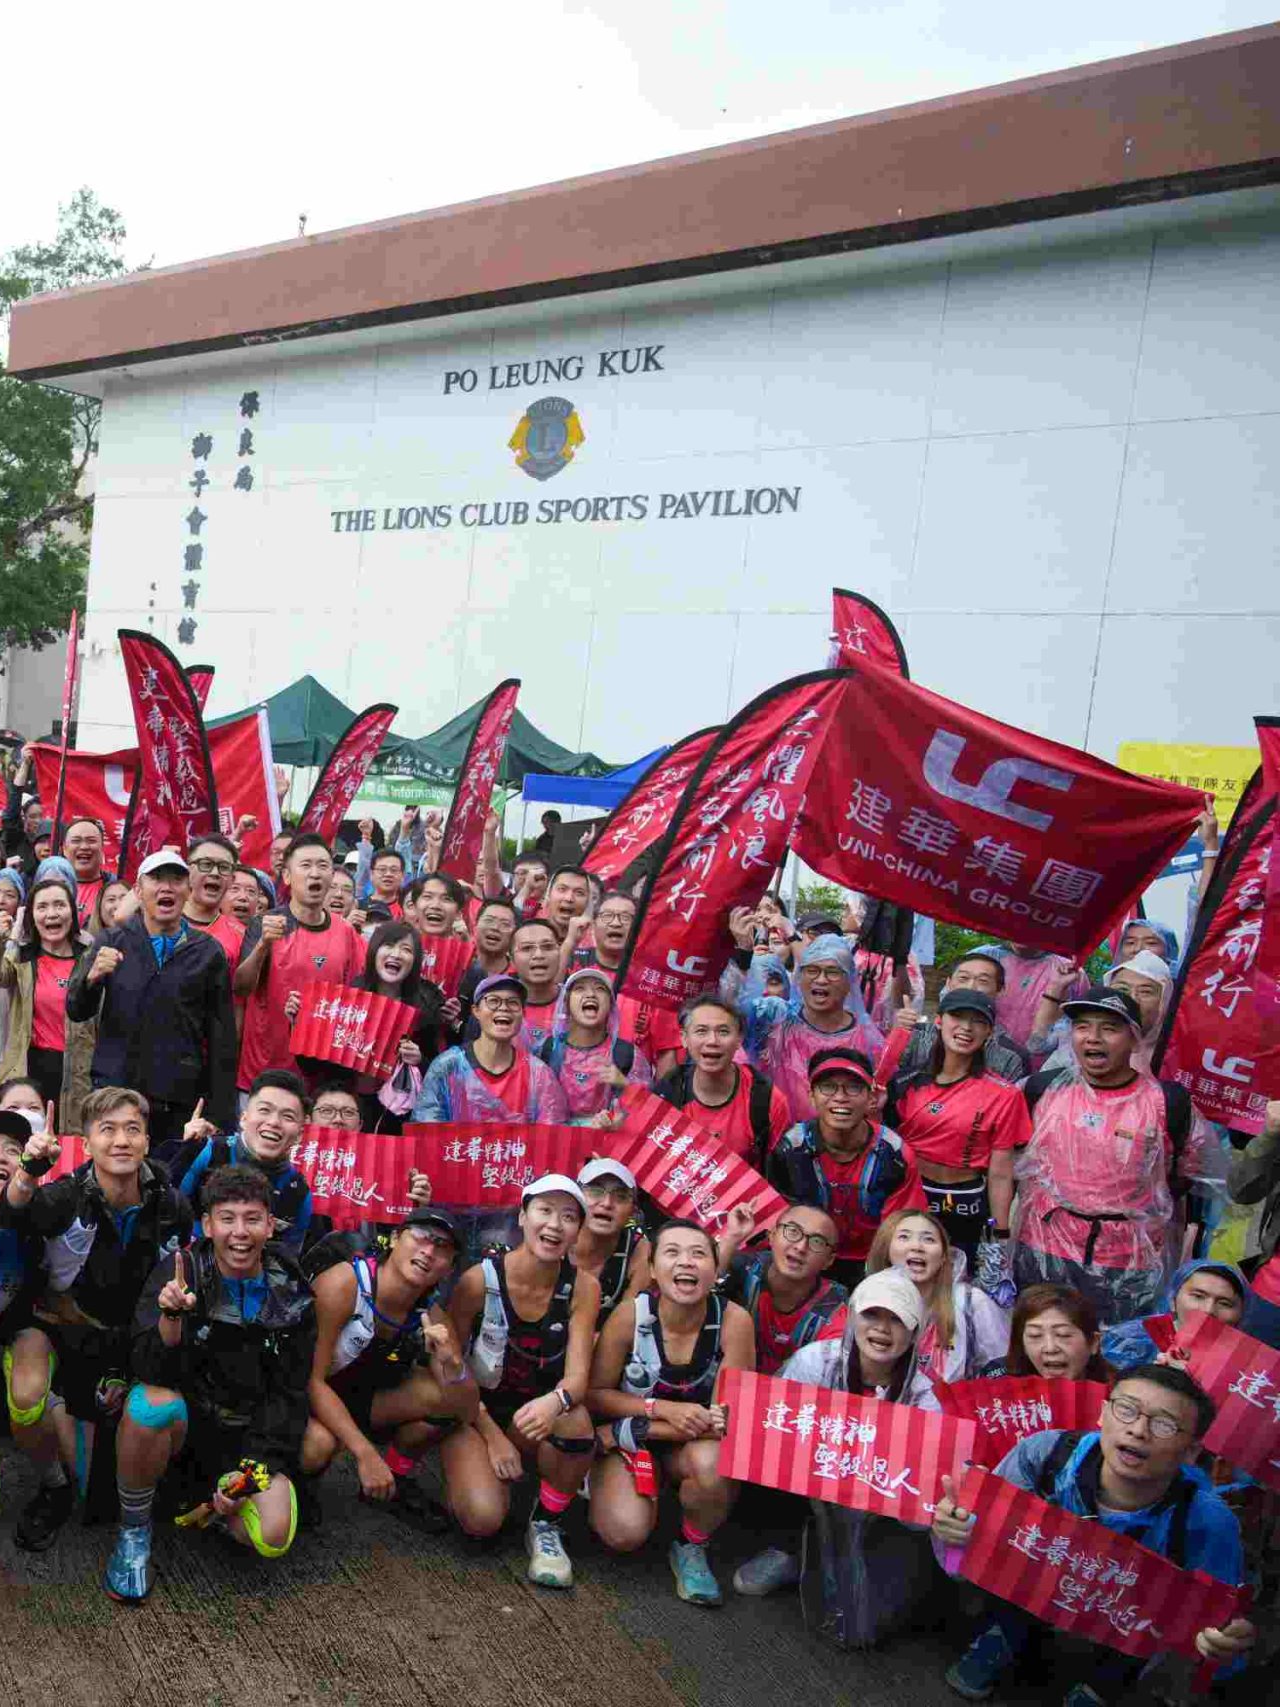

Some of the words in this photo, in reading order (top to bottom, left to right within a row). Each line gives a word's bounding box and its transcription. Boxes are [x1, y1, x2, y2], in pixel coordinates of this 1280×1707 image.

[443, 368, 478, 395] PO
[488, 356, 585, 391] LEUNG
[598, 344, 666, 378] KUK
[233, 390, 260, 492] 保良局
[330, 510, 376, 533] THE
[382, 505, 452, 531] LIONS
[459, 500, 529, 528] CLUB
[536, 494, 649, 525] SPORTS
[658, 486, 802, 520] PAVILION
[844, 777, 1105, 908] 建華集團
[837, 831, 960, 896] UNI-CHINA
[969, 887, 1076, 930] GROUP
[761, 1398, 878, 1458] 建華精神
[812, 1442, 921, 1500] 堅毅過人
